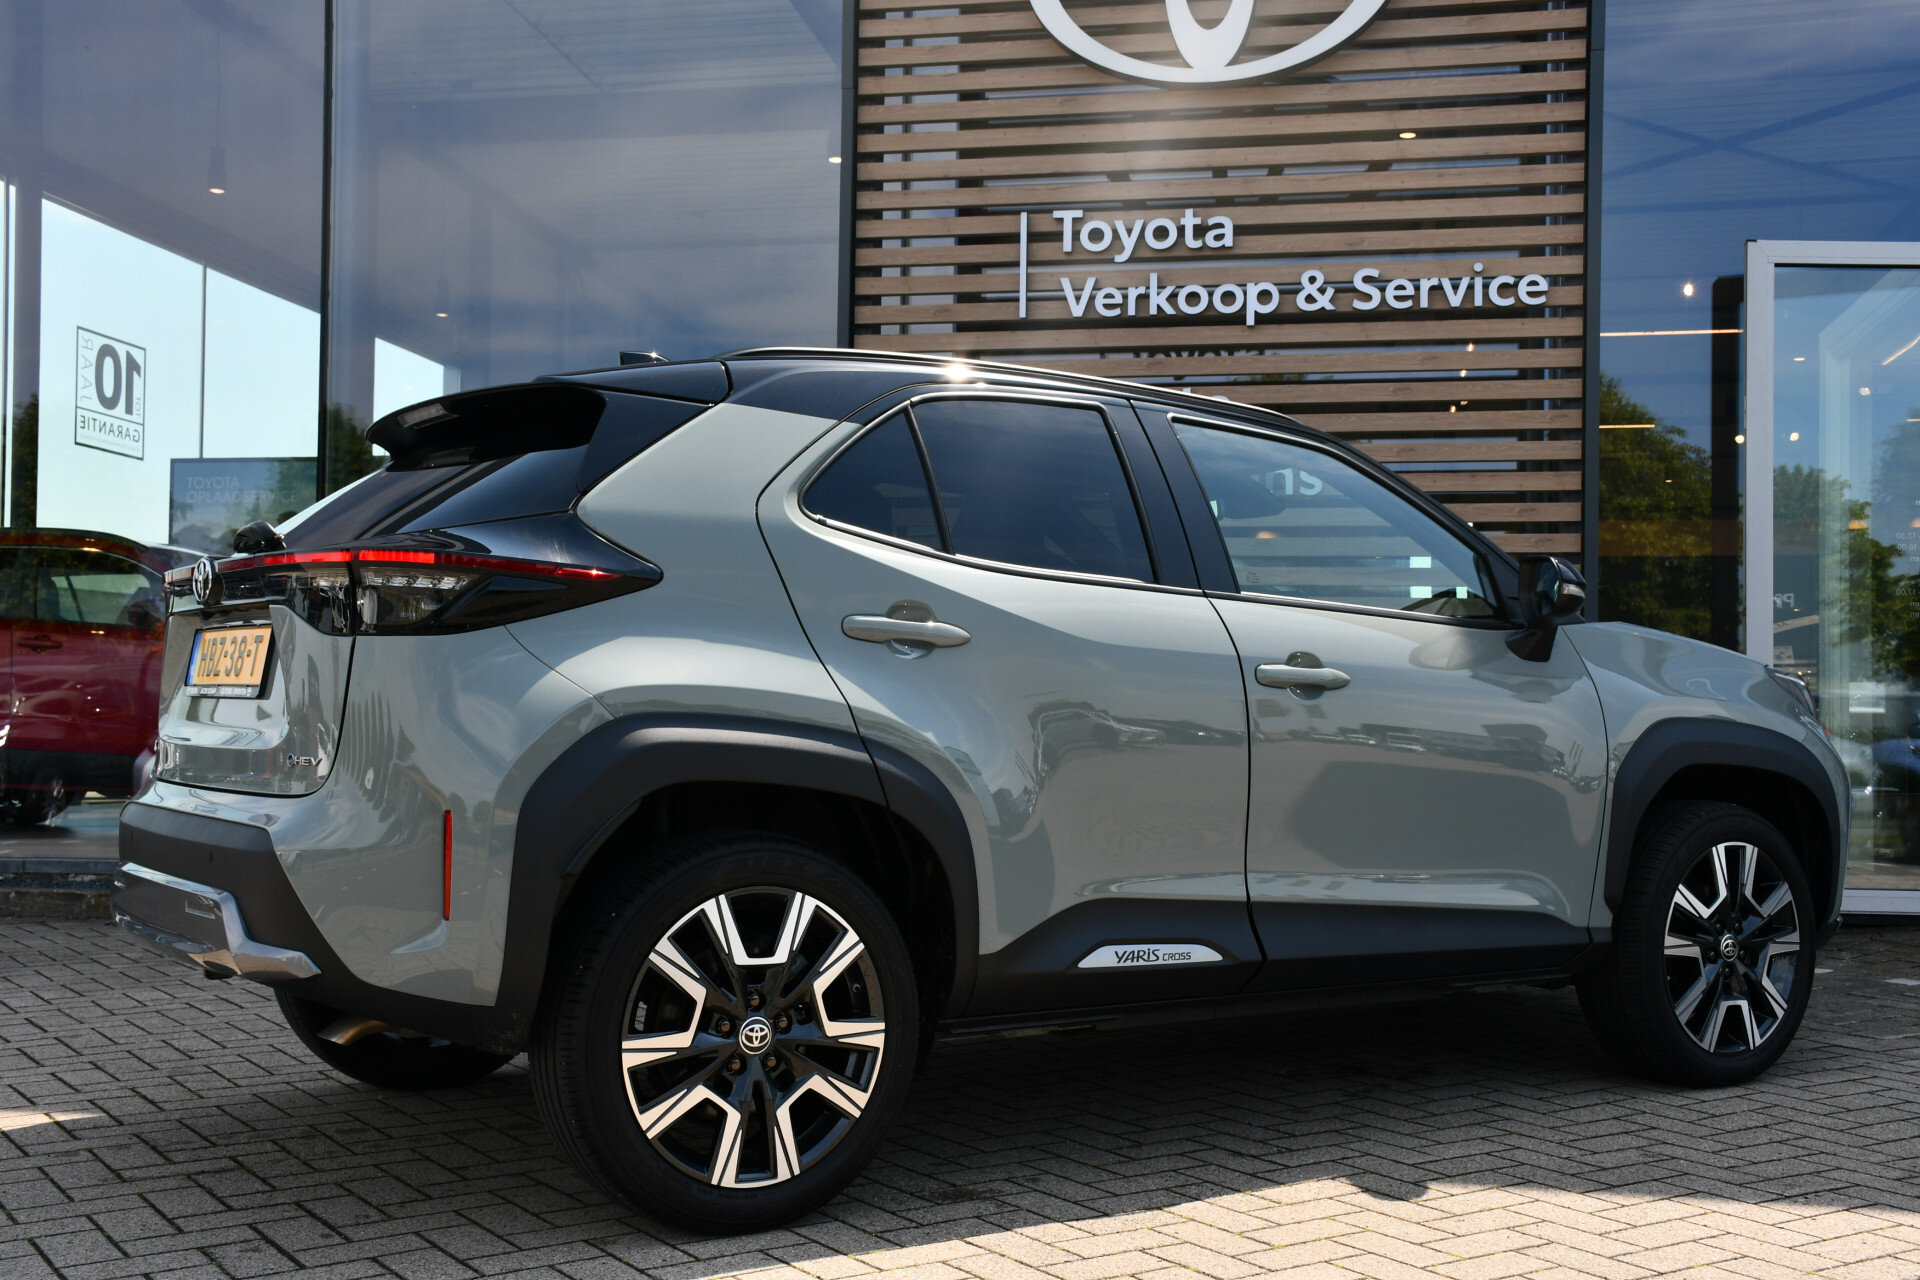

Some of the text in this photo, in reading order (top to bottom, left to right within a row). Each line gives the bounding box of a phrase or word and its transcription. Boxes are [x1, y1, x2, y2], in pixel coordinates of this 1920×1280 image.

[1052, 207, 1235, 263] Toyota
[1060, 262, 1549, 326] Verkoop & Service
[186, 476, 241, 490] TOYOTA
[197, 634, 265, 678] HBZ-38-T
[294, 756, 323, 767] HEV
[1162, 952, 1192, 962] CROSS
